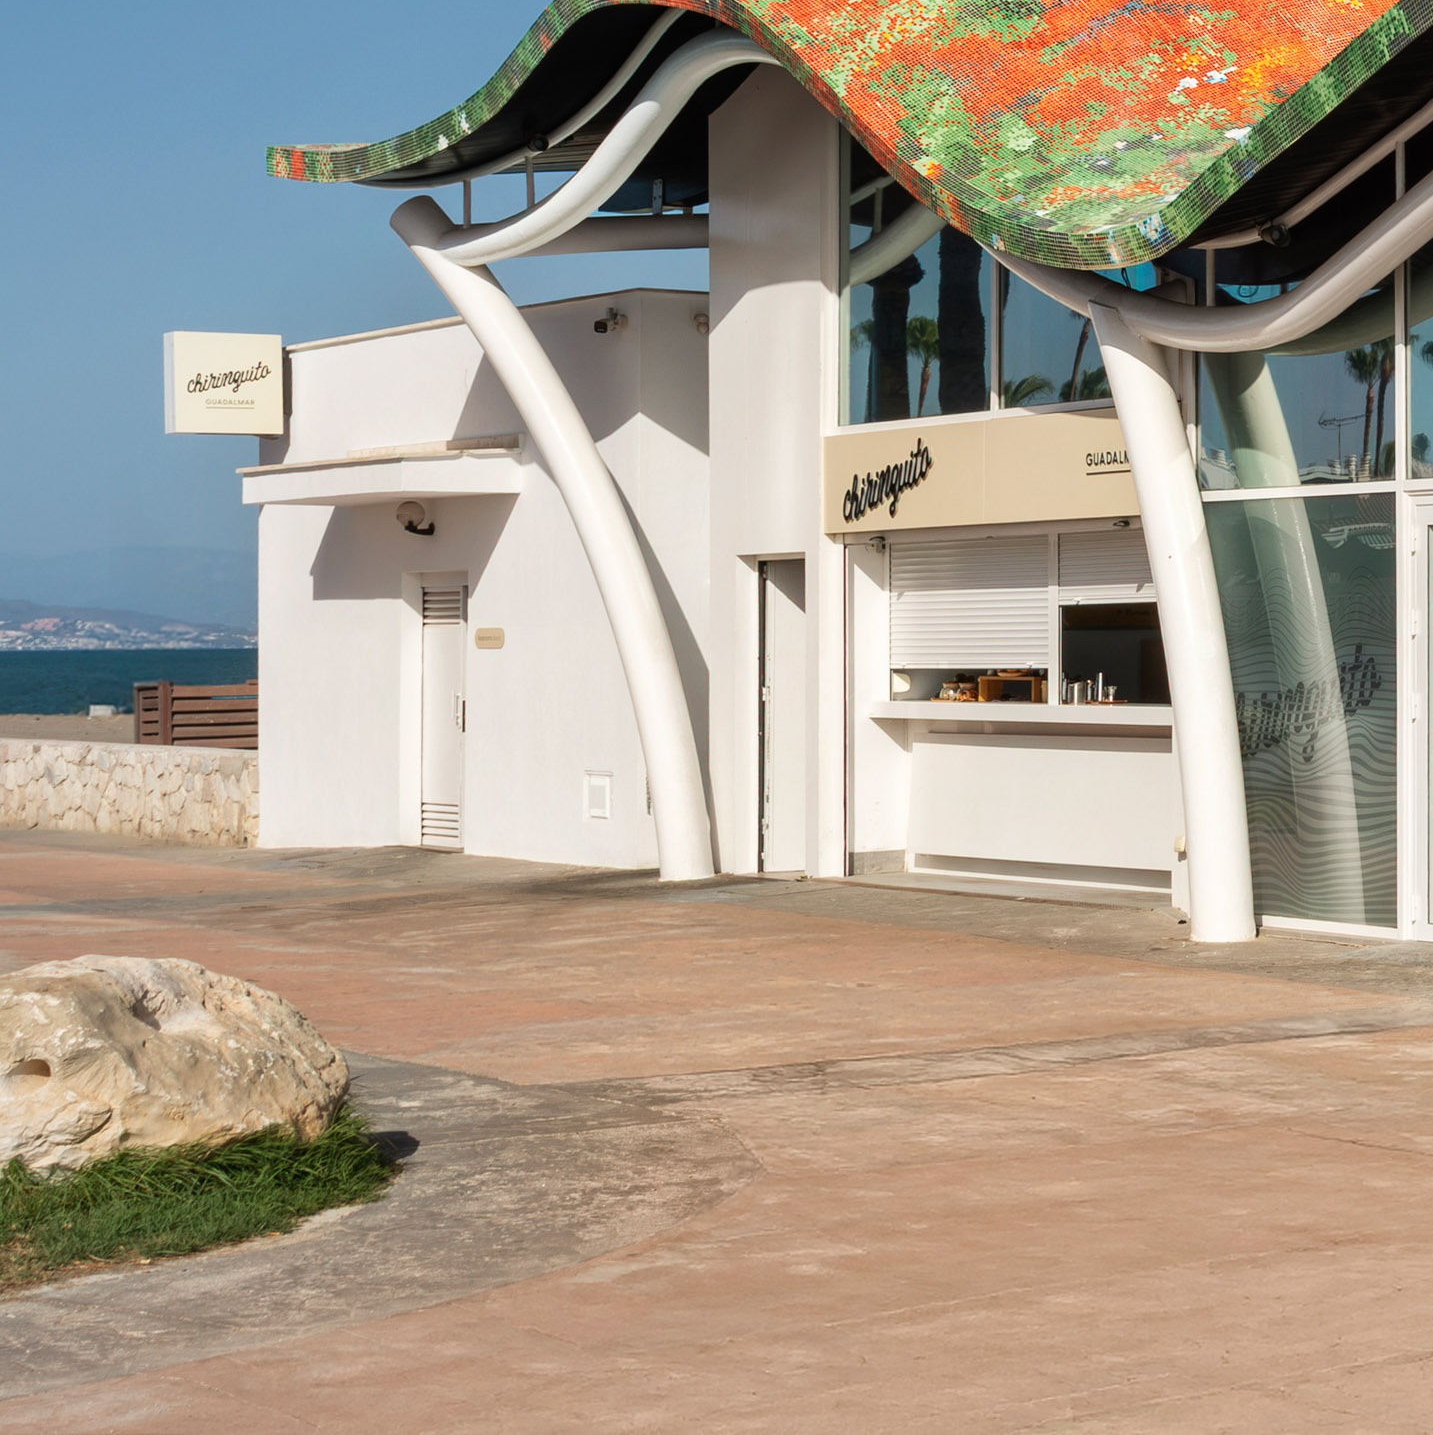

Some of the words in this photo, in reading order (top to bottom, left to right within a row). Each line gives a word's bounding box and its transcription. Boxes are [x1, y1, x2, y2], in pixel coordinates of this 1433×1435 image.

[187, 361, 271, 393] chiringuito
[205, 398, 255, 406] GUADALMAR
[843, 437, 933, 523] chiringuito
